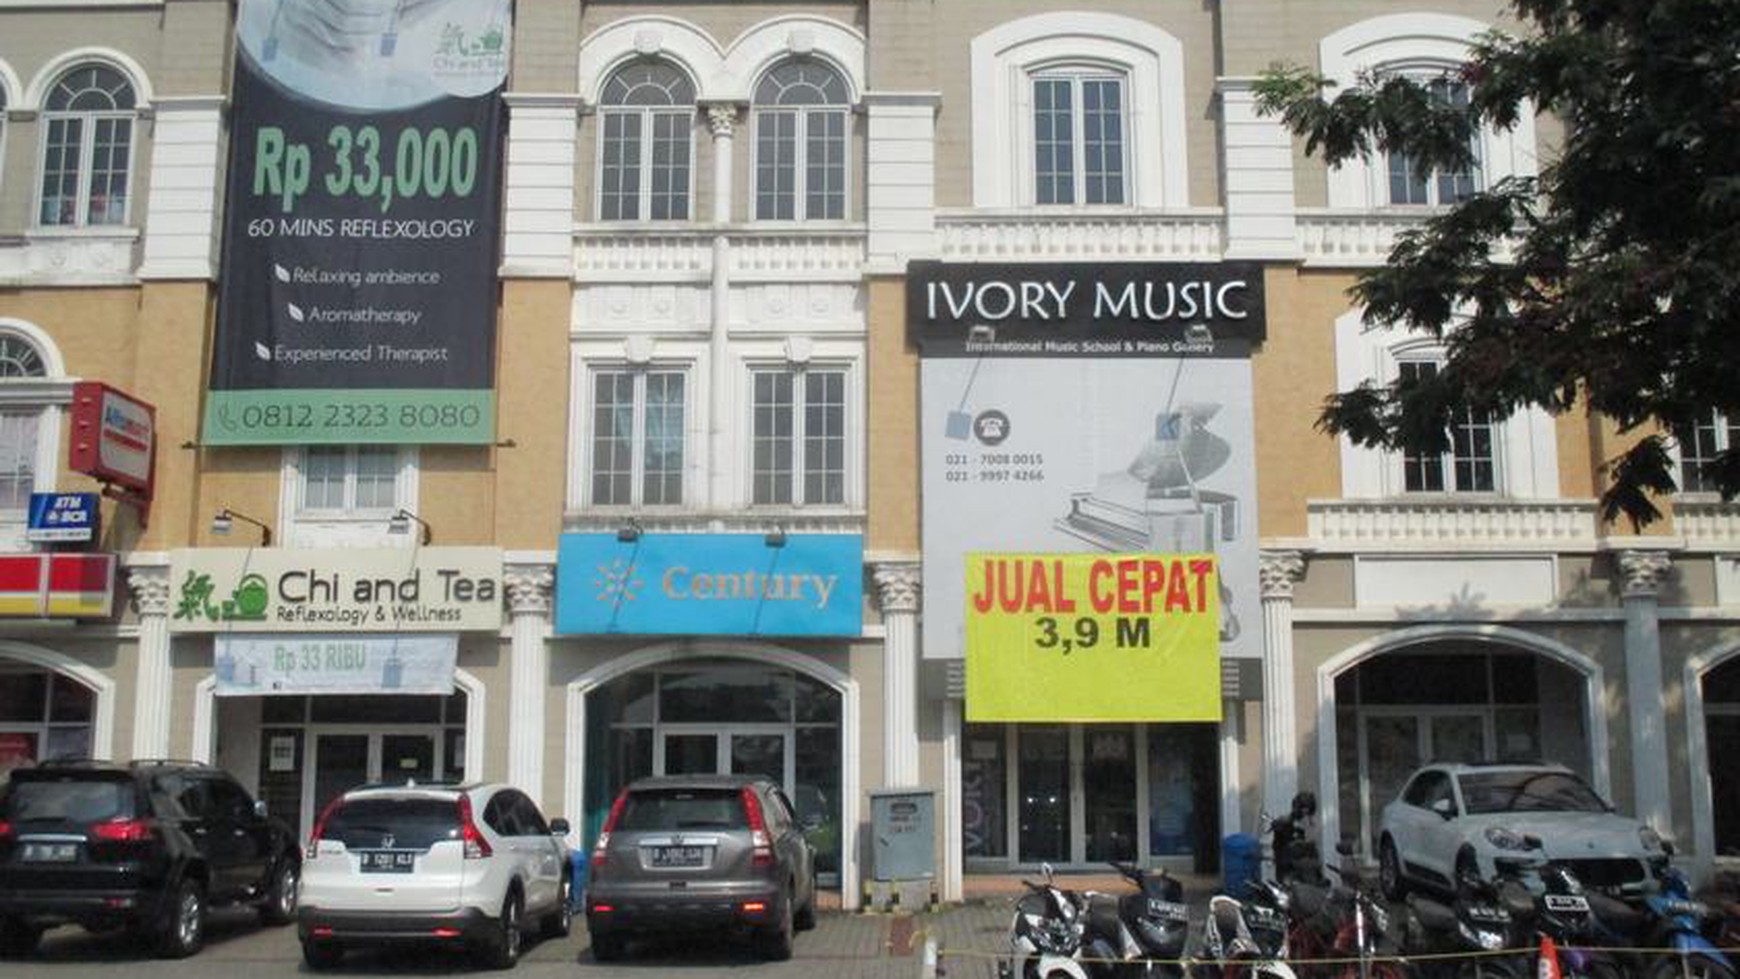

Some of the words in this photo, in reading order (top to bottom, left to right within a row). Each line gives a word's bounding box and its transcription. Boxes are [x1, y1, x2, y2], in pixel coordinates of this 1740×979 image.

[253, 127, 310, 213] Rp
[325, 126, 478, 213] 33,000
[248, 218, 274, 237] 60
[281, 219, 333, 236] MINS
[341, 220, 474, 237] REFLEXOLOGY
[293, 268, 360, 288] Relaxing
[366, 269, 440, 284] ambience
[926, 280, 1076, 320] IVORY
[1093, 280, 1248, 319] MUSIC
[308, 306, 422, 324] Aromatherapy
[275, 346, 371, 364] Experienced
[378, 346, 448, 363] Therapist
[966, 341, 1042, 353] International
[1045, 341, 1078, 352] Music
[1082, 341, 1121, 352] School
[1124, 341, 1133, 352] &
[1136, 341, 1169, 352] Piano
[243, 405, 312, 428] 0812
[324, 404, 388, 427] 2323
[401, 404, 479, 427] 8080
[277, 569, 339, 602] Chi
[353, 571, 420, 601] and
[437, 570, 496, 601] Tea
[662, 566, 837, 608] Century
[973, 560, 1075, 613] JUAL
[1090, 558, 1214, 613] CEPAT
[277, 605, 369, 625] Reflexology
[376, 607, 386, 621] &
[393, 606, 462, 622] Wellness
[1035, 617, 1100, 655] 3,9
[1116, 617, 1151, 648] M
[273, 646, 297, 677] Rp
[301, 646, 321, 670] 33
[326, 644, 367, 671] RIBU
